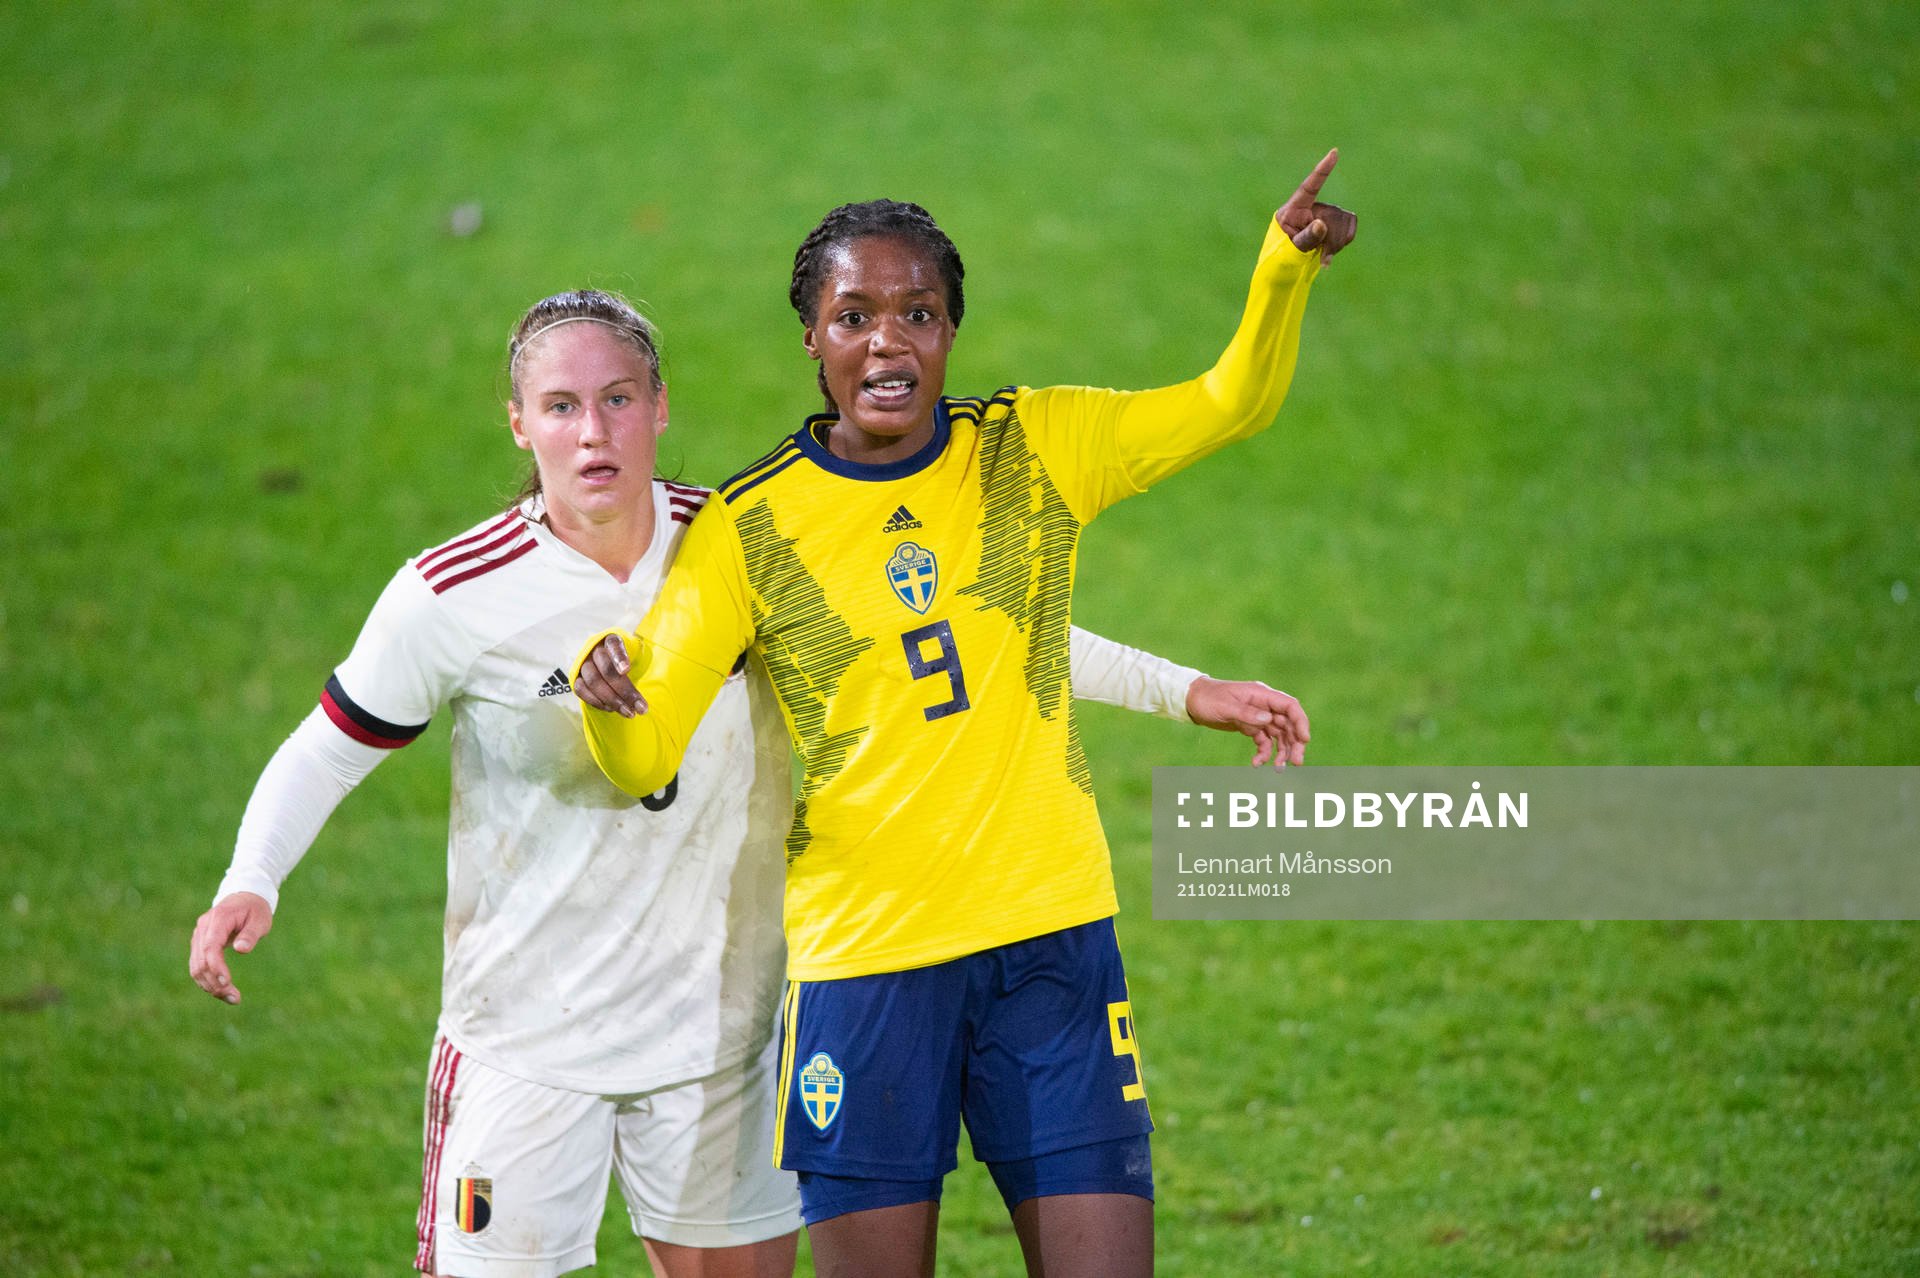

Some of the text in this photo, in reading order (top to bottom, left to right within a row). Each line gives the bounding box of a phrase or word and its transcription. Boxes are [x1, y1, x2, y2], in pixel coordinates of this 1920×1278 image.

[882, 520, 923, 533] adidas
[895, 559, 926, 572] SVERIGE
[901, 619, 970, 722] 9
[538, 684, 572, 697] adida
[1107, 1001, 1146, 1102] 9
[807, 1075, 836, 1083] SVERIGE
